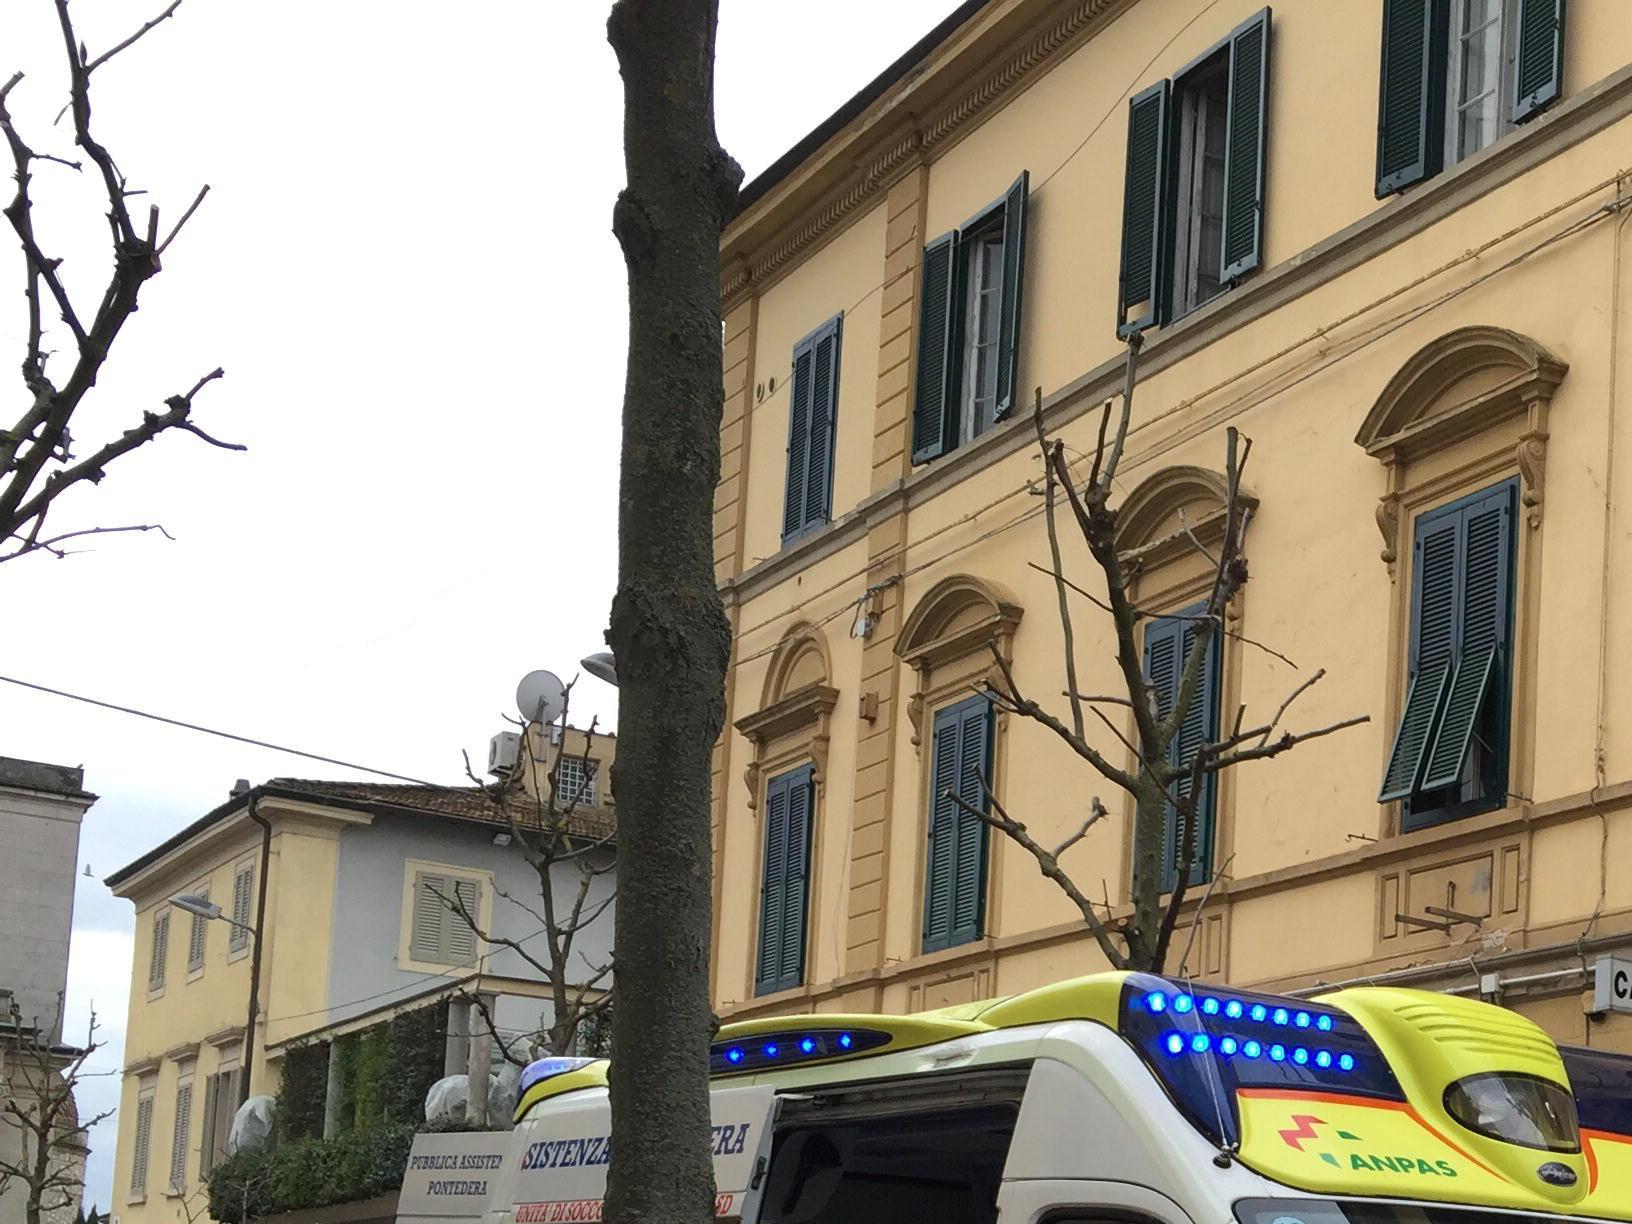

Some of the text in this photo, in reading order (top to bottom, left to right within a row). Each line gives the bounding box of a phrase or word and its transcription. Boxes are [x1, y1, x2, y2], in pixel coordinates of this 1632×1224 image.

[410, 1155, 458, 1171] PUBBLICA
[1351, 1154, 1458, 1177] ANPAS
[427, 1180, 488, 1196] PONTEDERA
